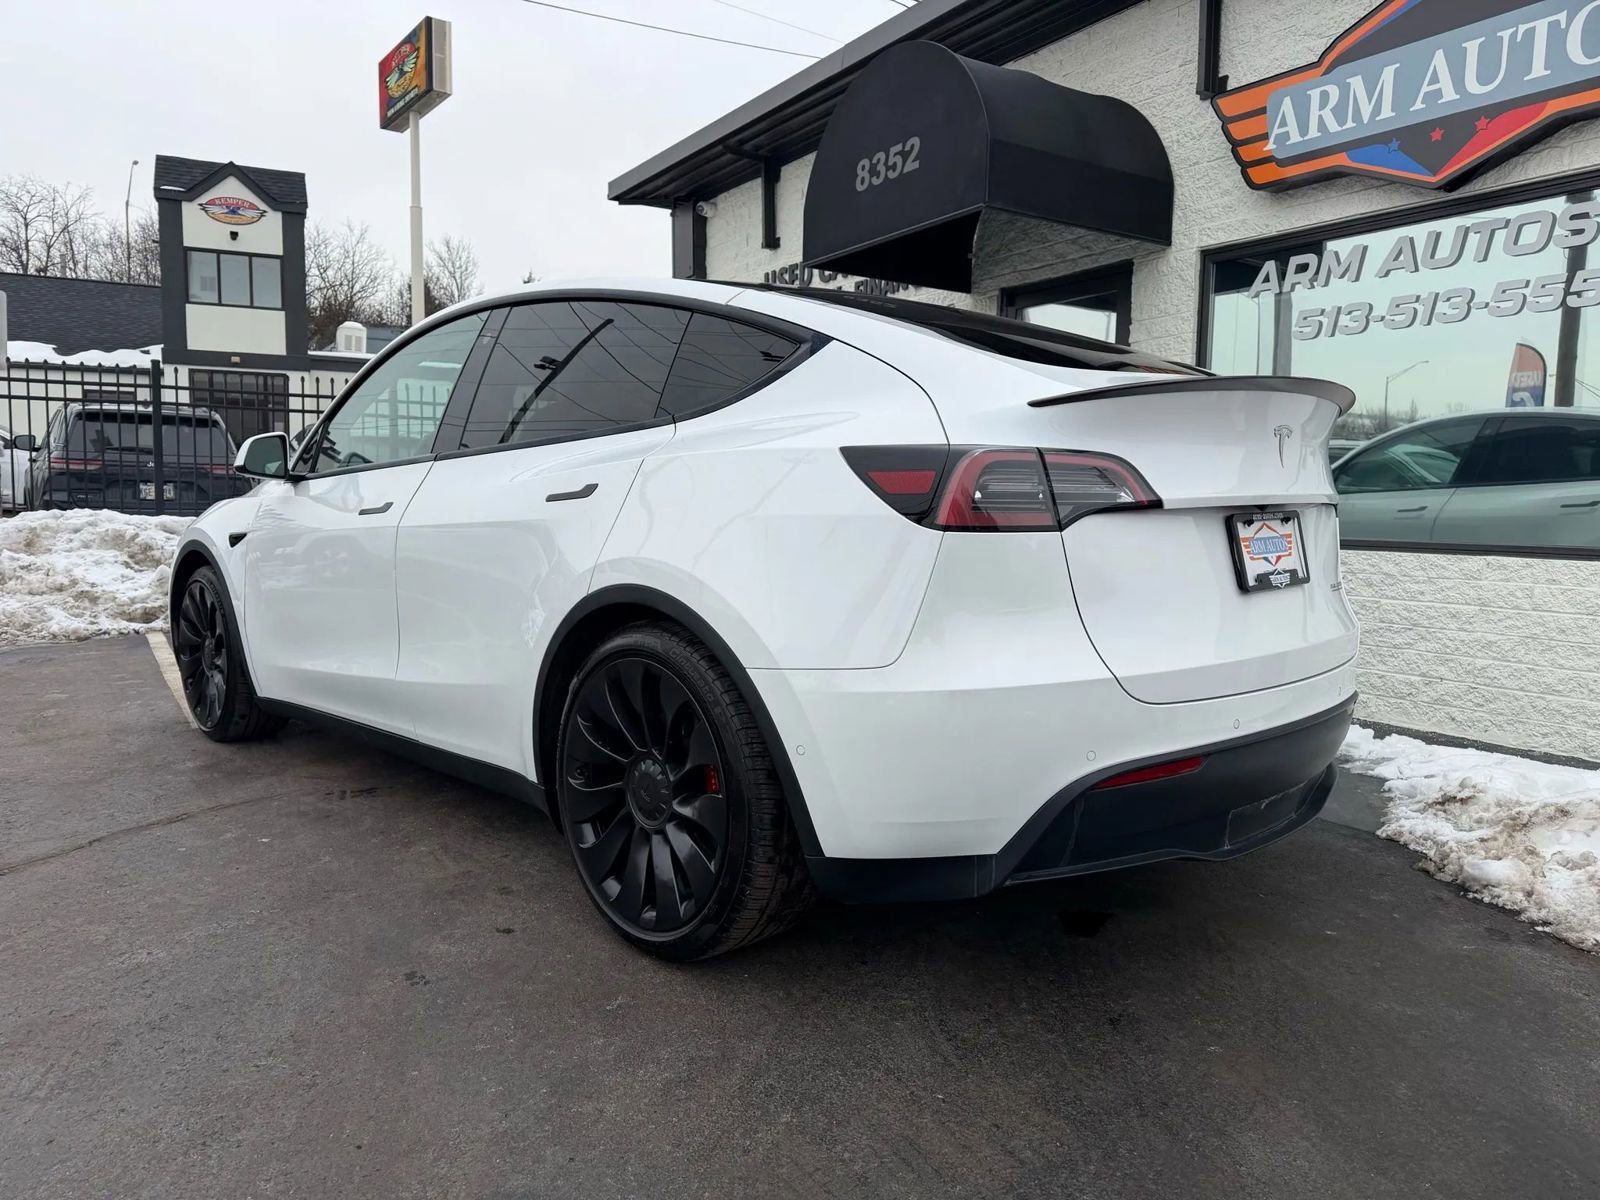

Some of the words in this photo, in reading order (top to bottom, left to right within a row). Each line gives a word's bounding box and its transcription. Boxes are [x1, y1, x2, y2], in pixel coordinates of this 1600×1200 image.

[1263, 62, 1400, 151] ARM
[855, 136, 921, 192] 8352
[214, 197, 251, 208] KEMPER
[1249, 243, 1369, 298] ARM
[1374, 202, 1600, 279] AUTOS
[1250, 539, 1267, 554] ARM
